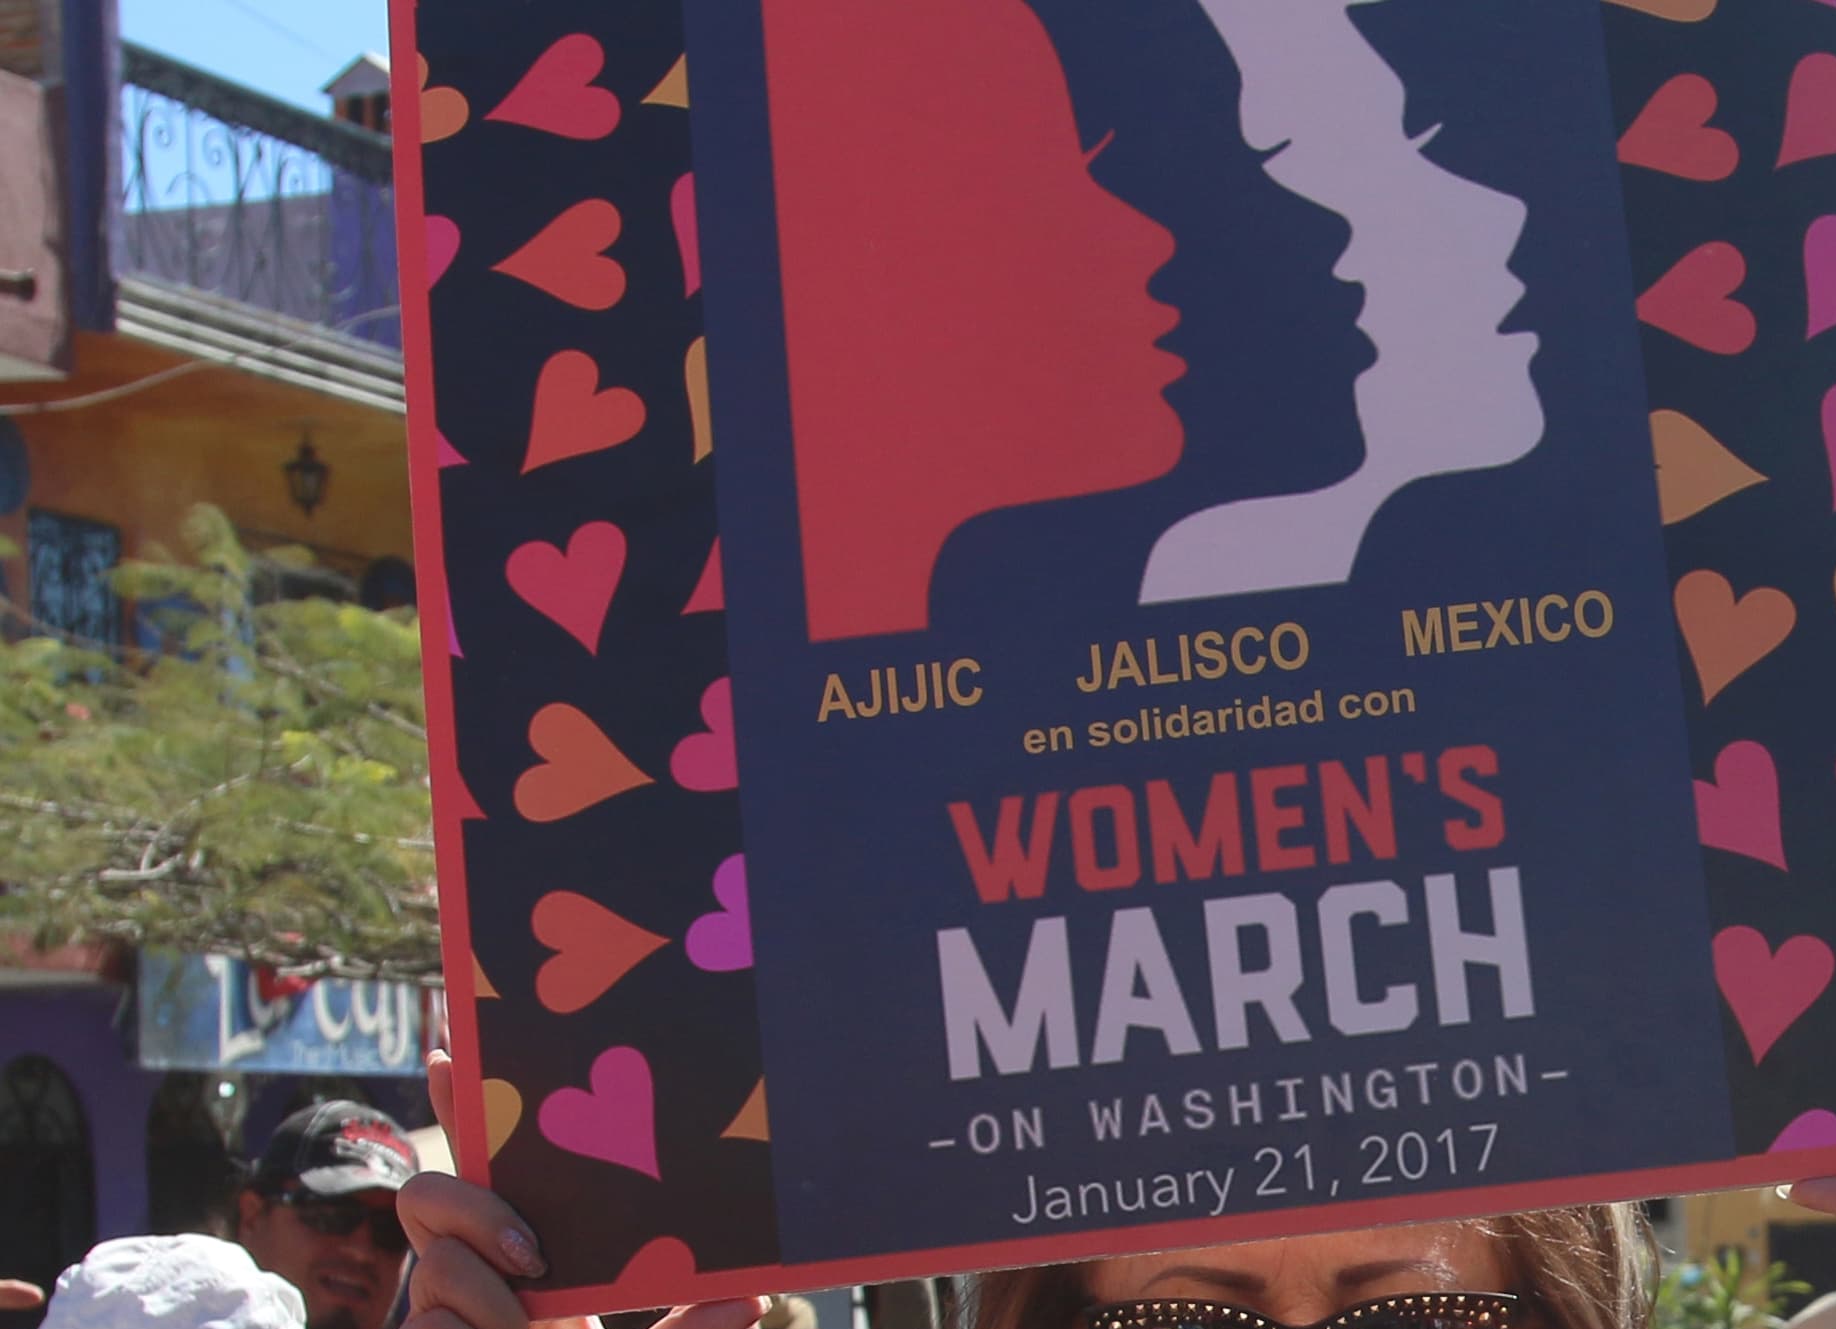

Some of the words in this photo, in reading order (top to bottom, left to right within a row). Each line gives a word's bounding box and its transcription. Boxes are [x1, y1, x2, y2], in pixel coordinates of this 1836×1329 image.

[817, 657, 983, 722] AJIJIC
[1076, 622, 1309, 693] JALISCO
[1402, 590, 1613, 656] MEXICO
[1024, 726, 1073, 753] en
[1084, 688, 1324, 746] solidaridad
[1339, 689, 1415, 718] con
[947, 744, 1507, 905] WOMEN'S
[936, 866, 1535, 1081] MARCH
[1011, 1166, 1235, 1225] January
[1253, 1143, 1339, 1197] 21,
[1360, 1124, 1497, 1183] 2017
